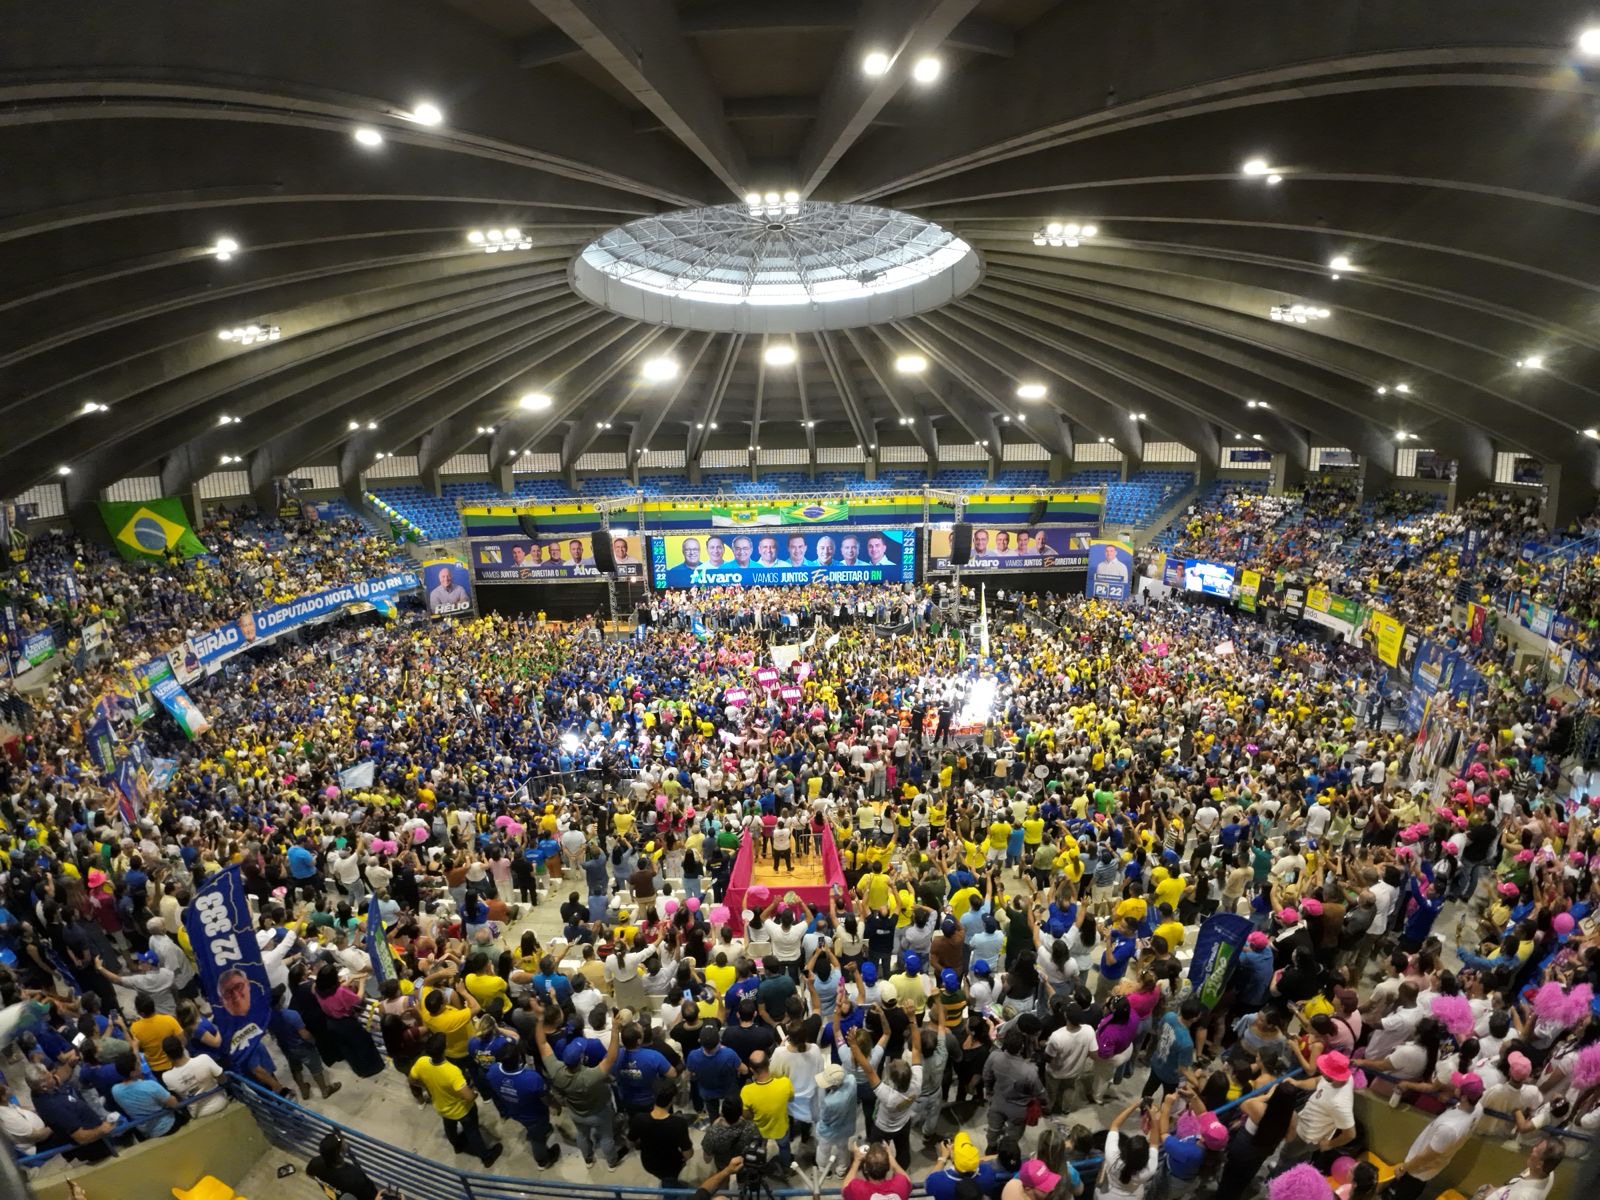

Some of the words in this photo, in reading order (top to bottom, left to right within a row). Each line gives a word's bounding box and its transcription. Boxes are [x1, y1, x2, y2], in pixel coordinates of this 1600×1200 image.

[903, 538, 915, 546] 22
[654, 547, 664, 555] 22
[903, 555, 914, 564] 22
[655, 564, 666, 573] 22
[752, 573, 778, 583] VAMOS
[780, 572, 808, 582] JUNTOS
[864, 571, 869, 580] O
[871, 571, 882, 580] RN
[656, 581, 667, 589] 22
[1096, 586, 1107, 595] PL
[1110, 586, 1121, 596] 22
[258, 617, 266, 629] O
[268, 598, 323, 627] DEPUTADO
[325, 589, 354, 606] NOTA
[354, 582, 369, 598] 10
[371, 581, 386, 593] DO
[386, 577, 402, 588] RN
[195, 628, 238, 658] GIRÃO
[195, 891, 231, 937] 333
[211, 934, 243, 966] 22
